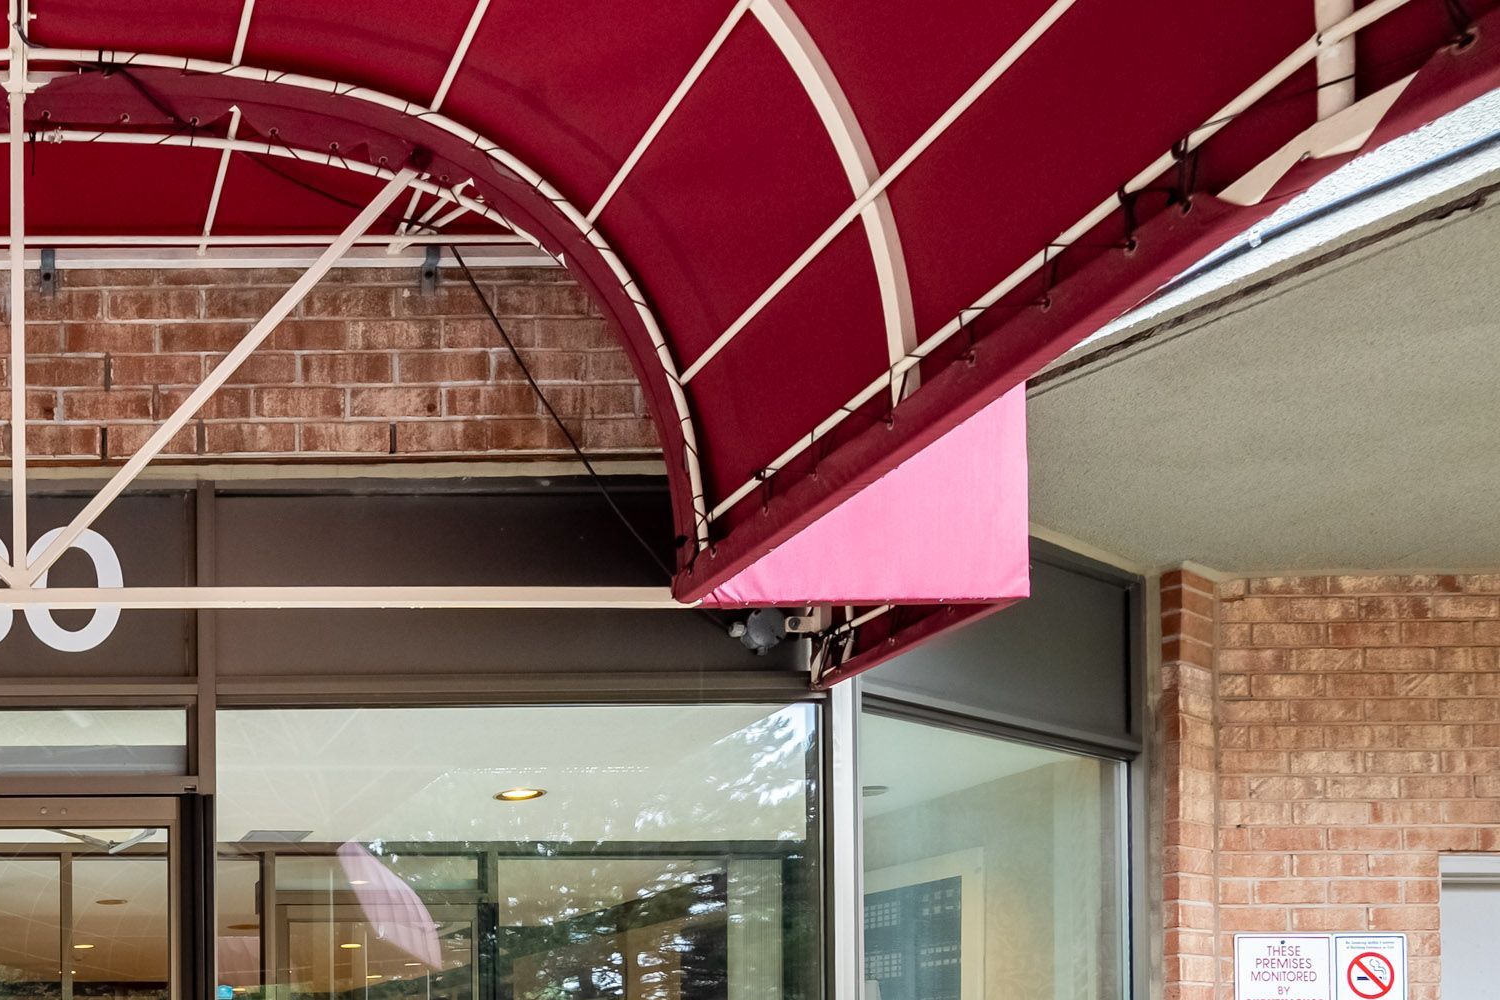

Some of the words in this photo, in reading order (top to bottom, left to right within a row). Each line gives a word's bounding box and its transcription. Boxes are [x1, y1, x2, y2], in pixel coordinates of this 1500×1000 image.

[1267, 945, 1301, 957] THESE
[1255, 958, 1312, 969] PREMISES
[1250, 970, 1318, 982] MONITORED
[1277, 985, 1290, 995] BY
